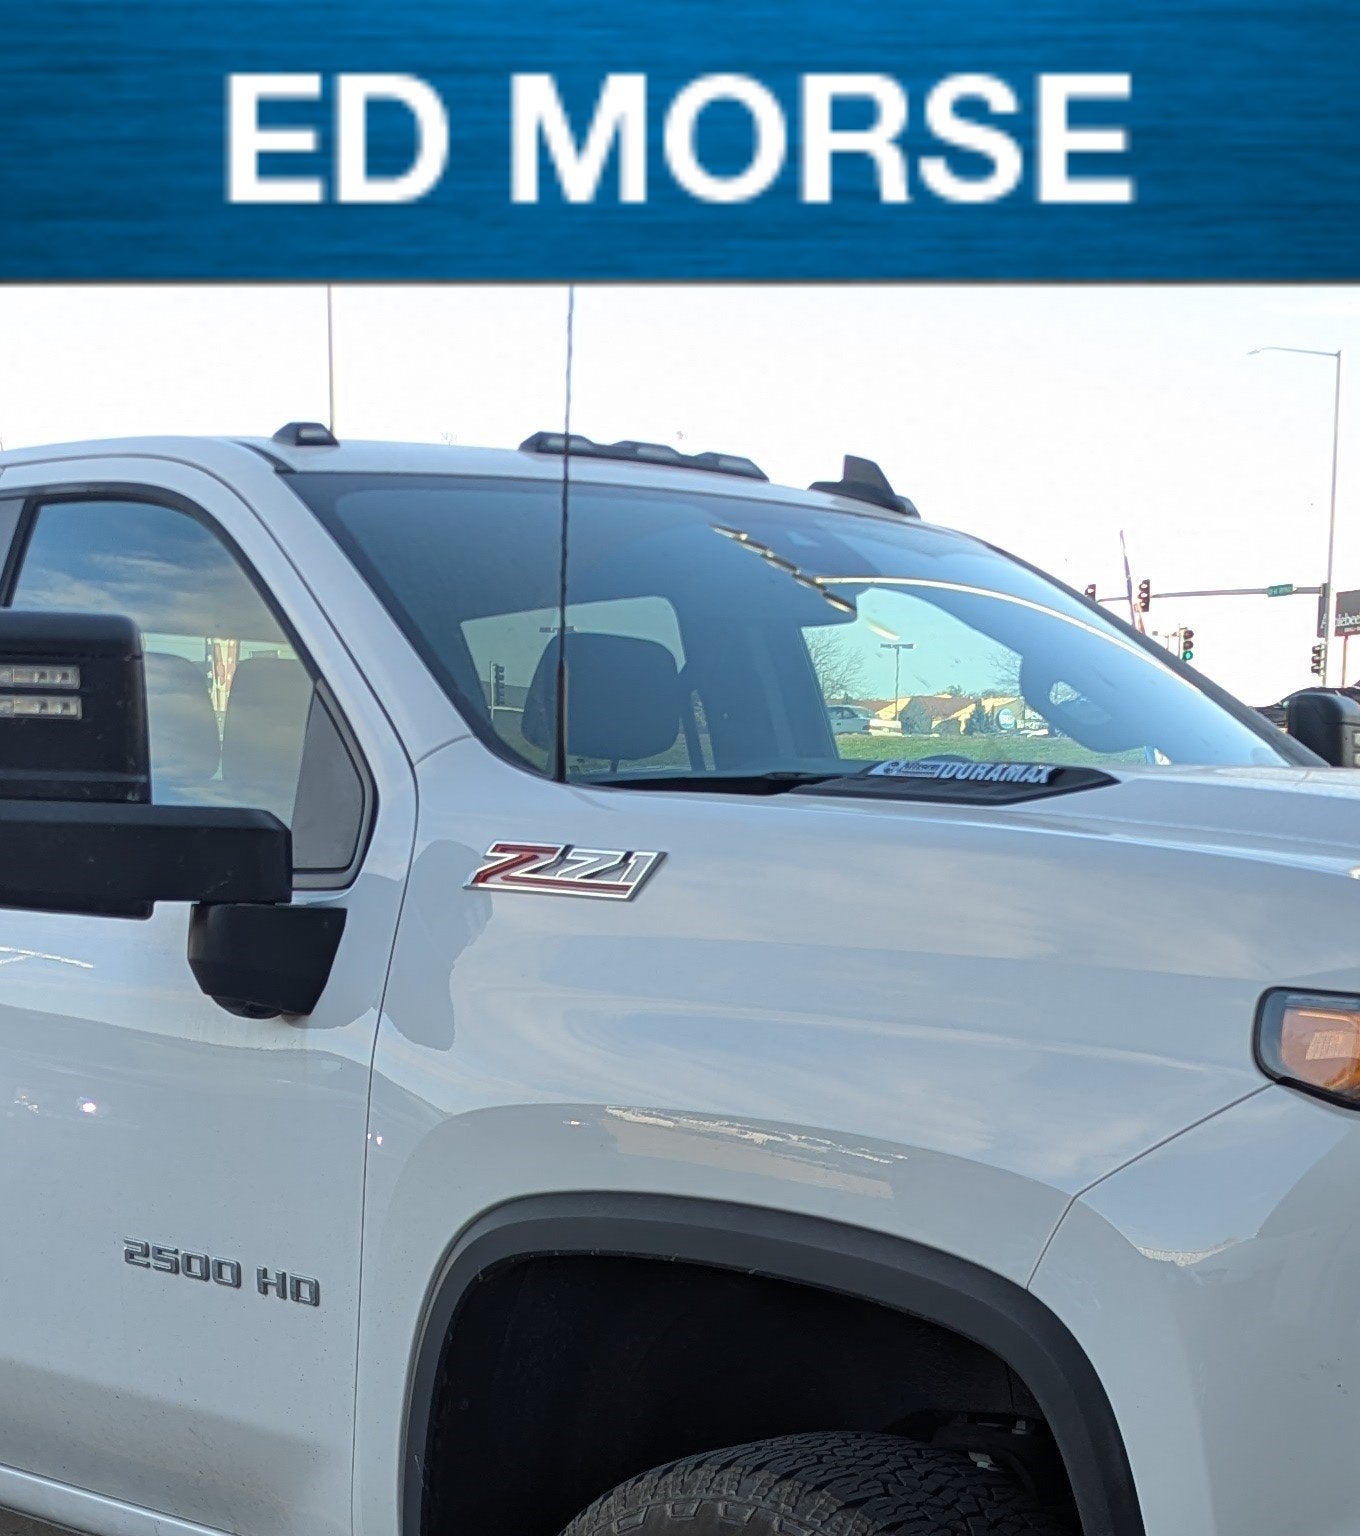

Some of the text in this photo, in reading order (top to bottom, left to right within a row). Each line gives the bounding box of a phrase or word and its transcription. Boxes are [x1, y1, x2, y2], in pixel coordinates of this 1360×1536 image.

[936, 763, 1051, 784] DURAMAX
[463, 839, 668, 902] Z71
[123, 1236, 321, 1307] 2500 HD
